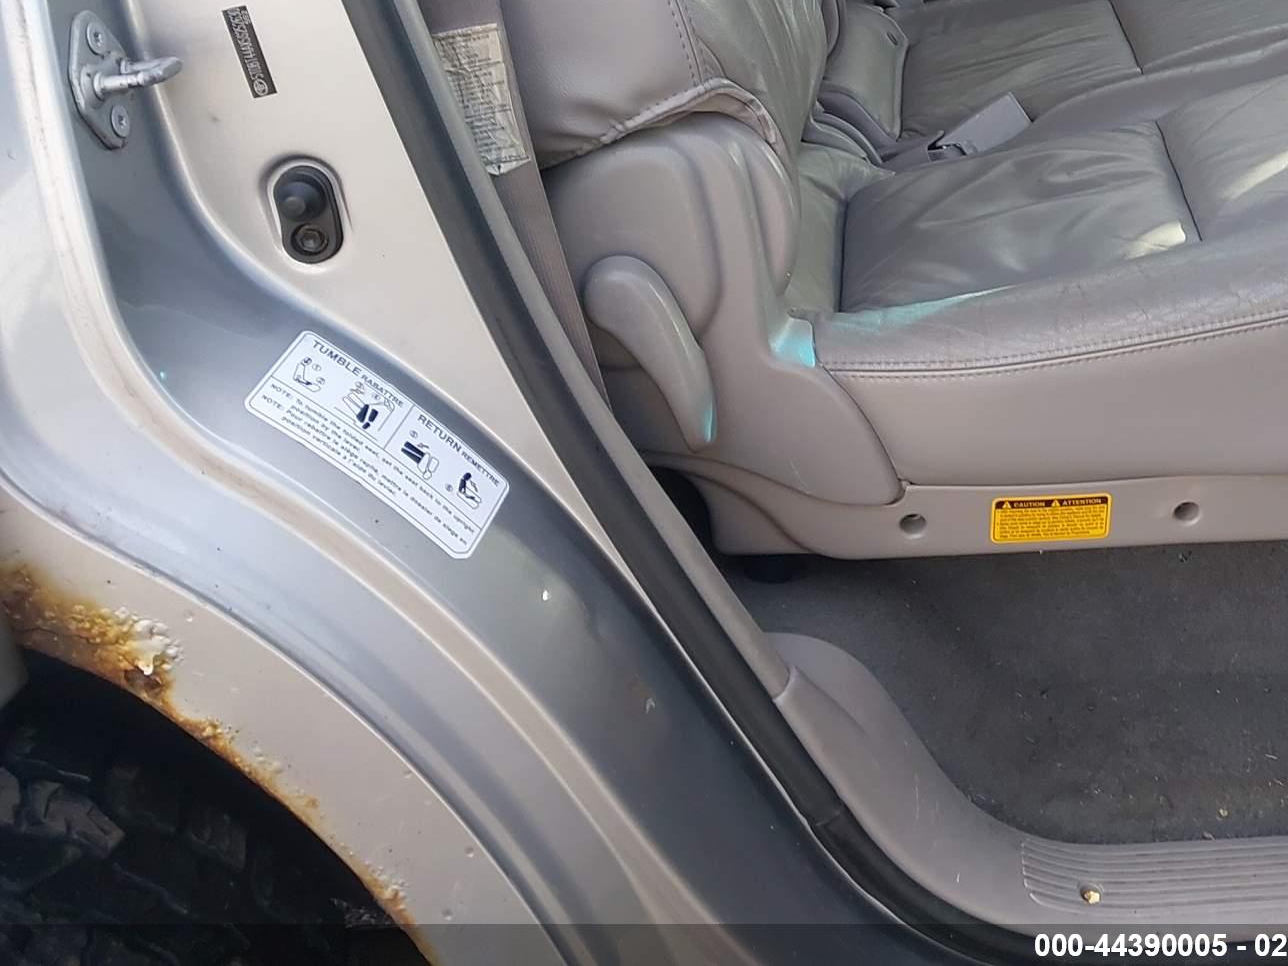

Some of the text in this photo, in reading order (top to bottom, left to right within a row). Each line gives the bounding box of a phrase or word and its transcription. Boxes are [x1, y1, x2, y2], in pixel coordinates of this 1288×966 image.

[312, 340, 403, 408] TUMBLE RABATTRE
[417, 414, 500, 488] RETURN REMETTRE
[1062, 498, 1102, 506] ATTENTION
